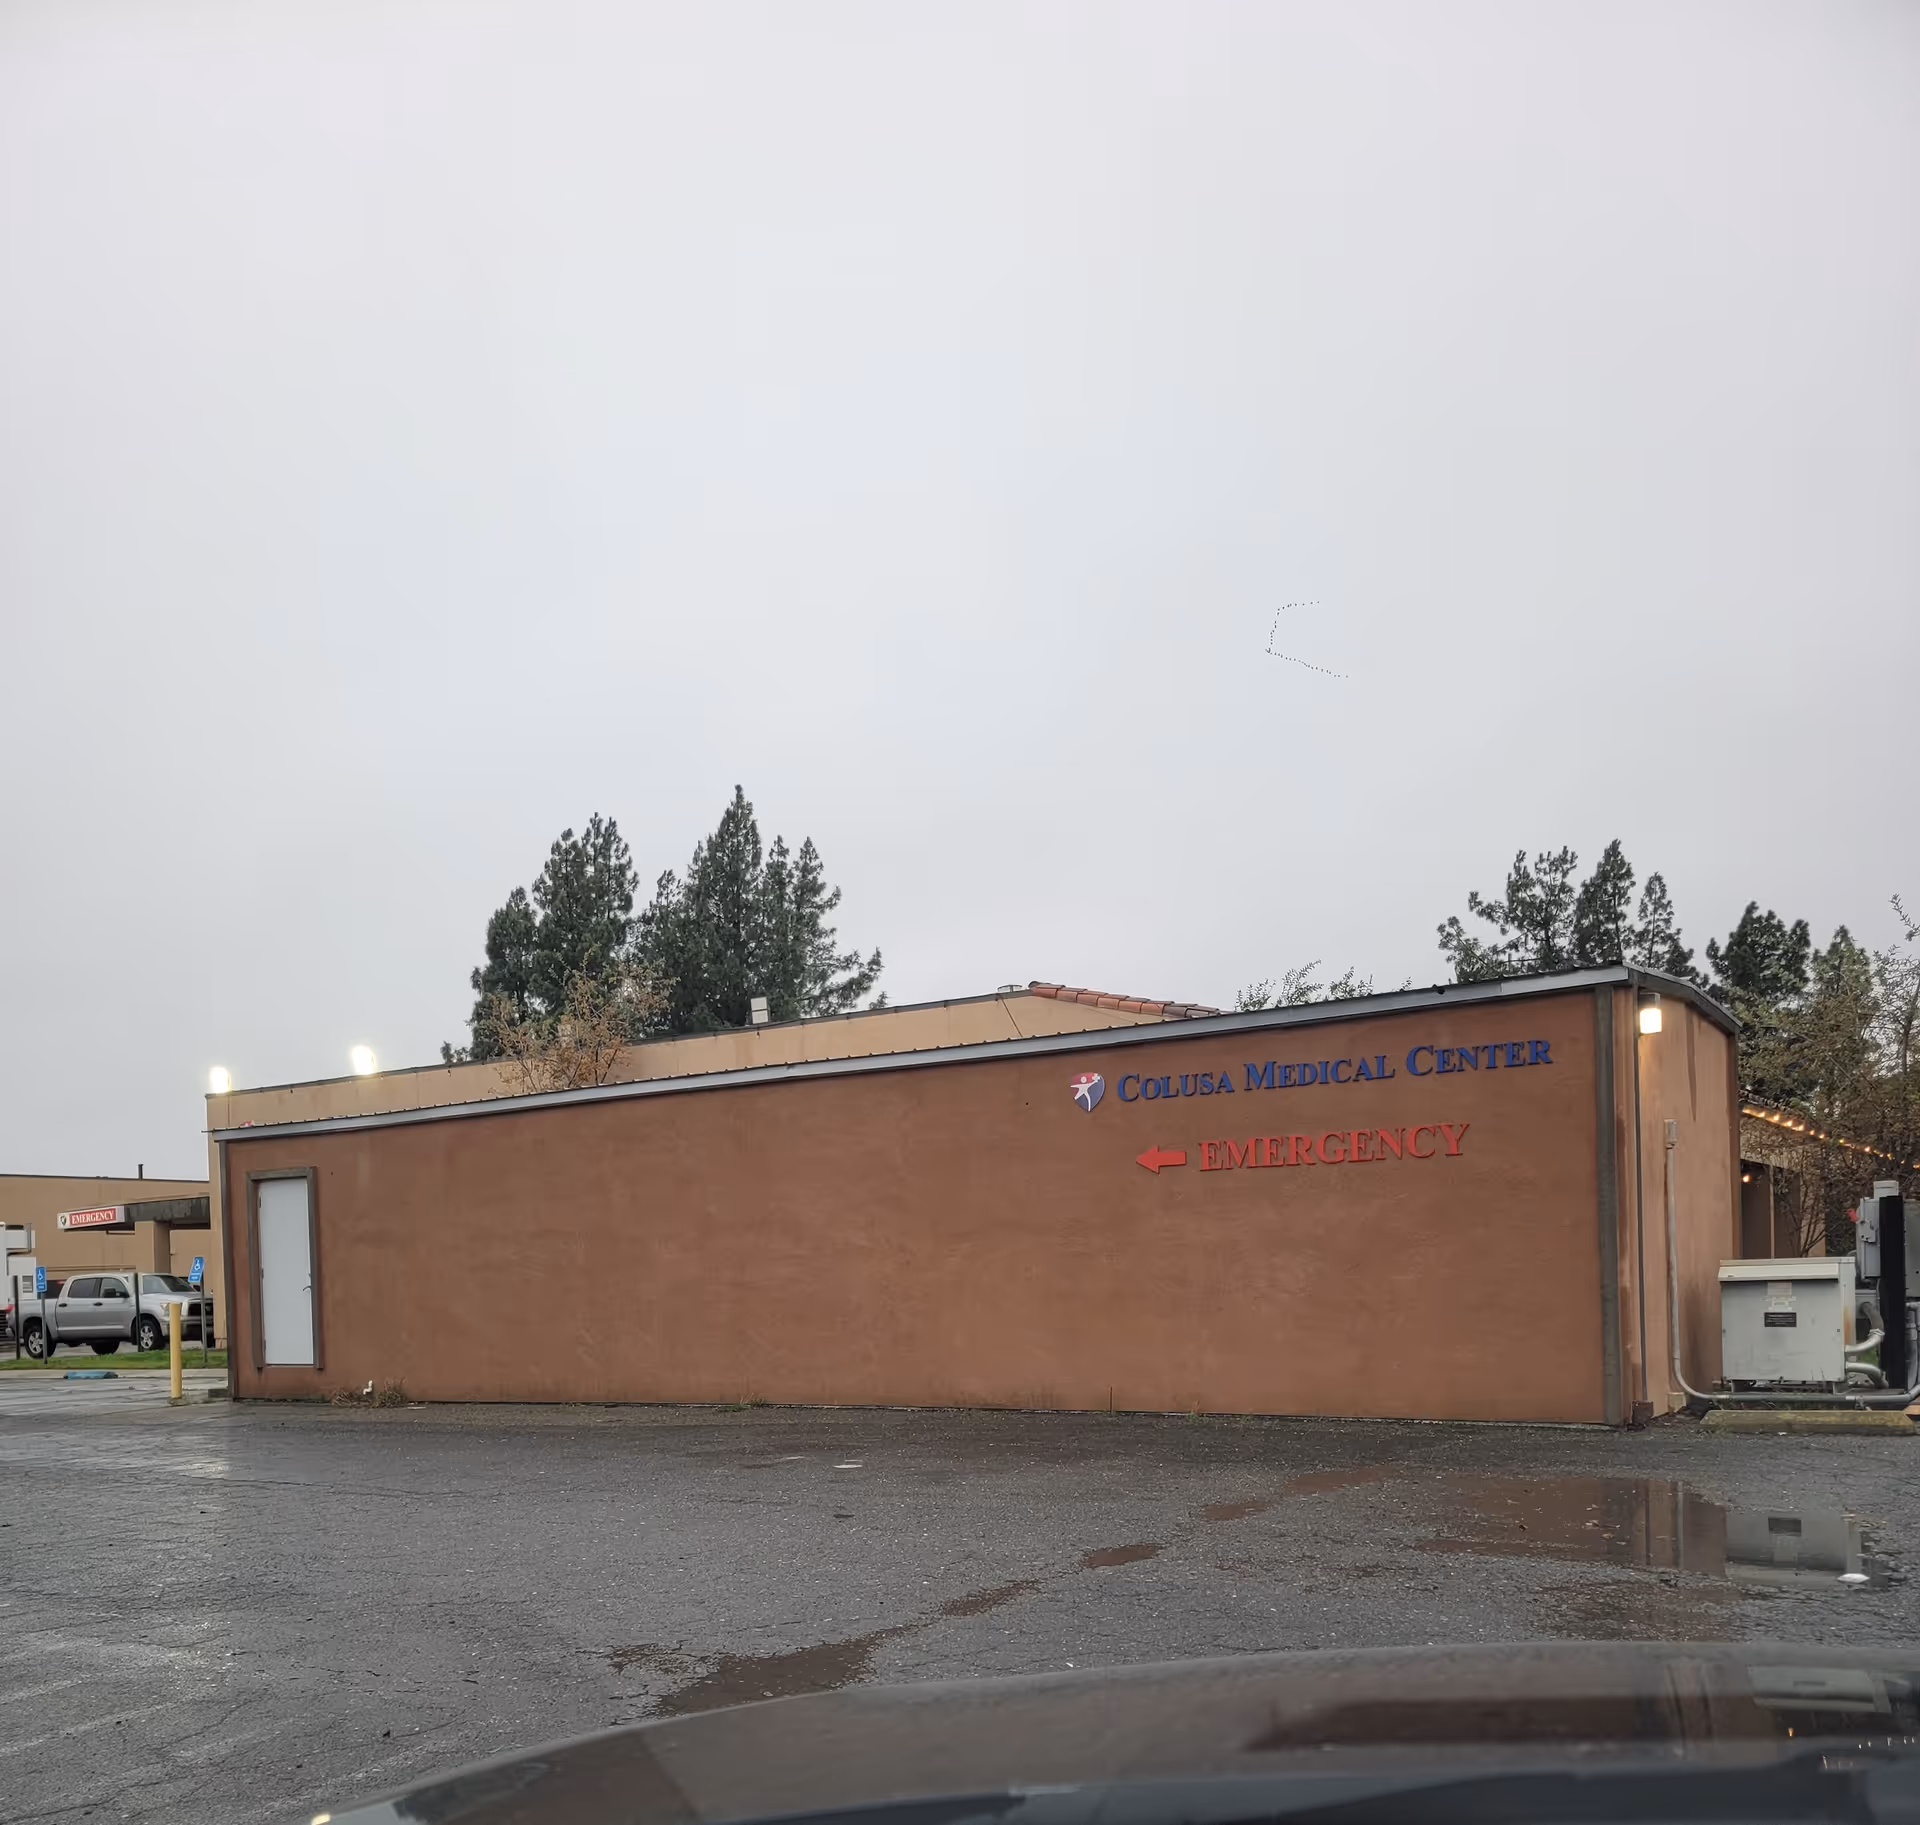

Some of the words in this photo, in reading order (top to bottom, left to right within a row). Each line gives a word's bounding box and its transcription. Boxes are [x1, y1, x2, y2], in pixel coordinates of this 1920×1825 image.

[1117, 1072, 1235, 1102] COLUSA
[1244, 1054, 1396, 1092] MEDICAL
[1405, 1038, 1554, 1077] CENTER
[1198, 1122, 1471, 1172] EMERGENCY
[71, 1210, 115, 1225] EMERGENCY
